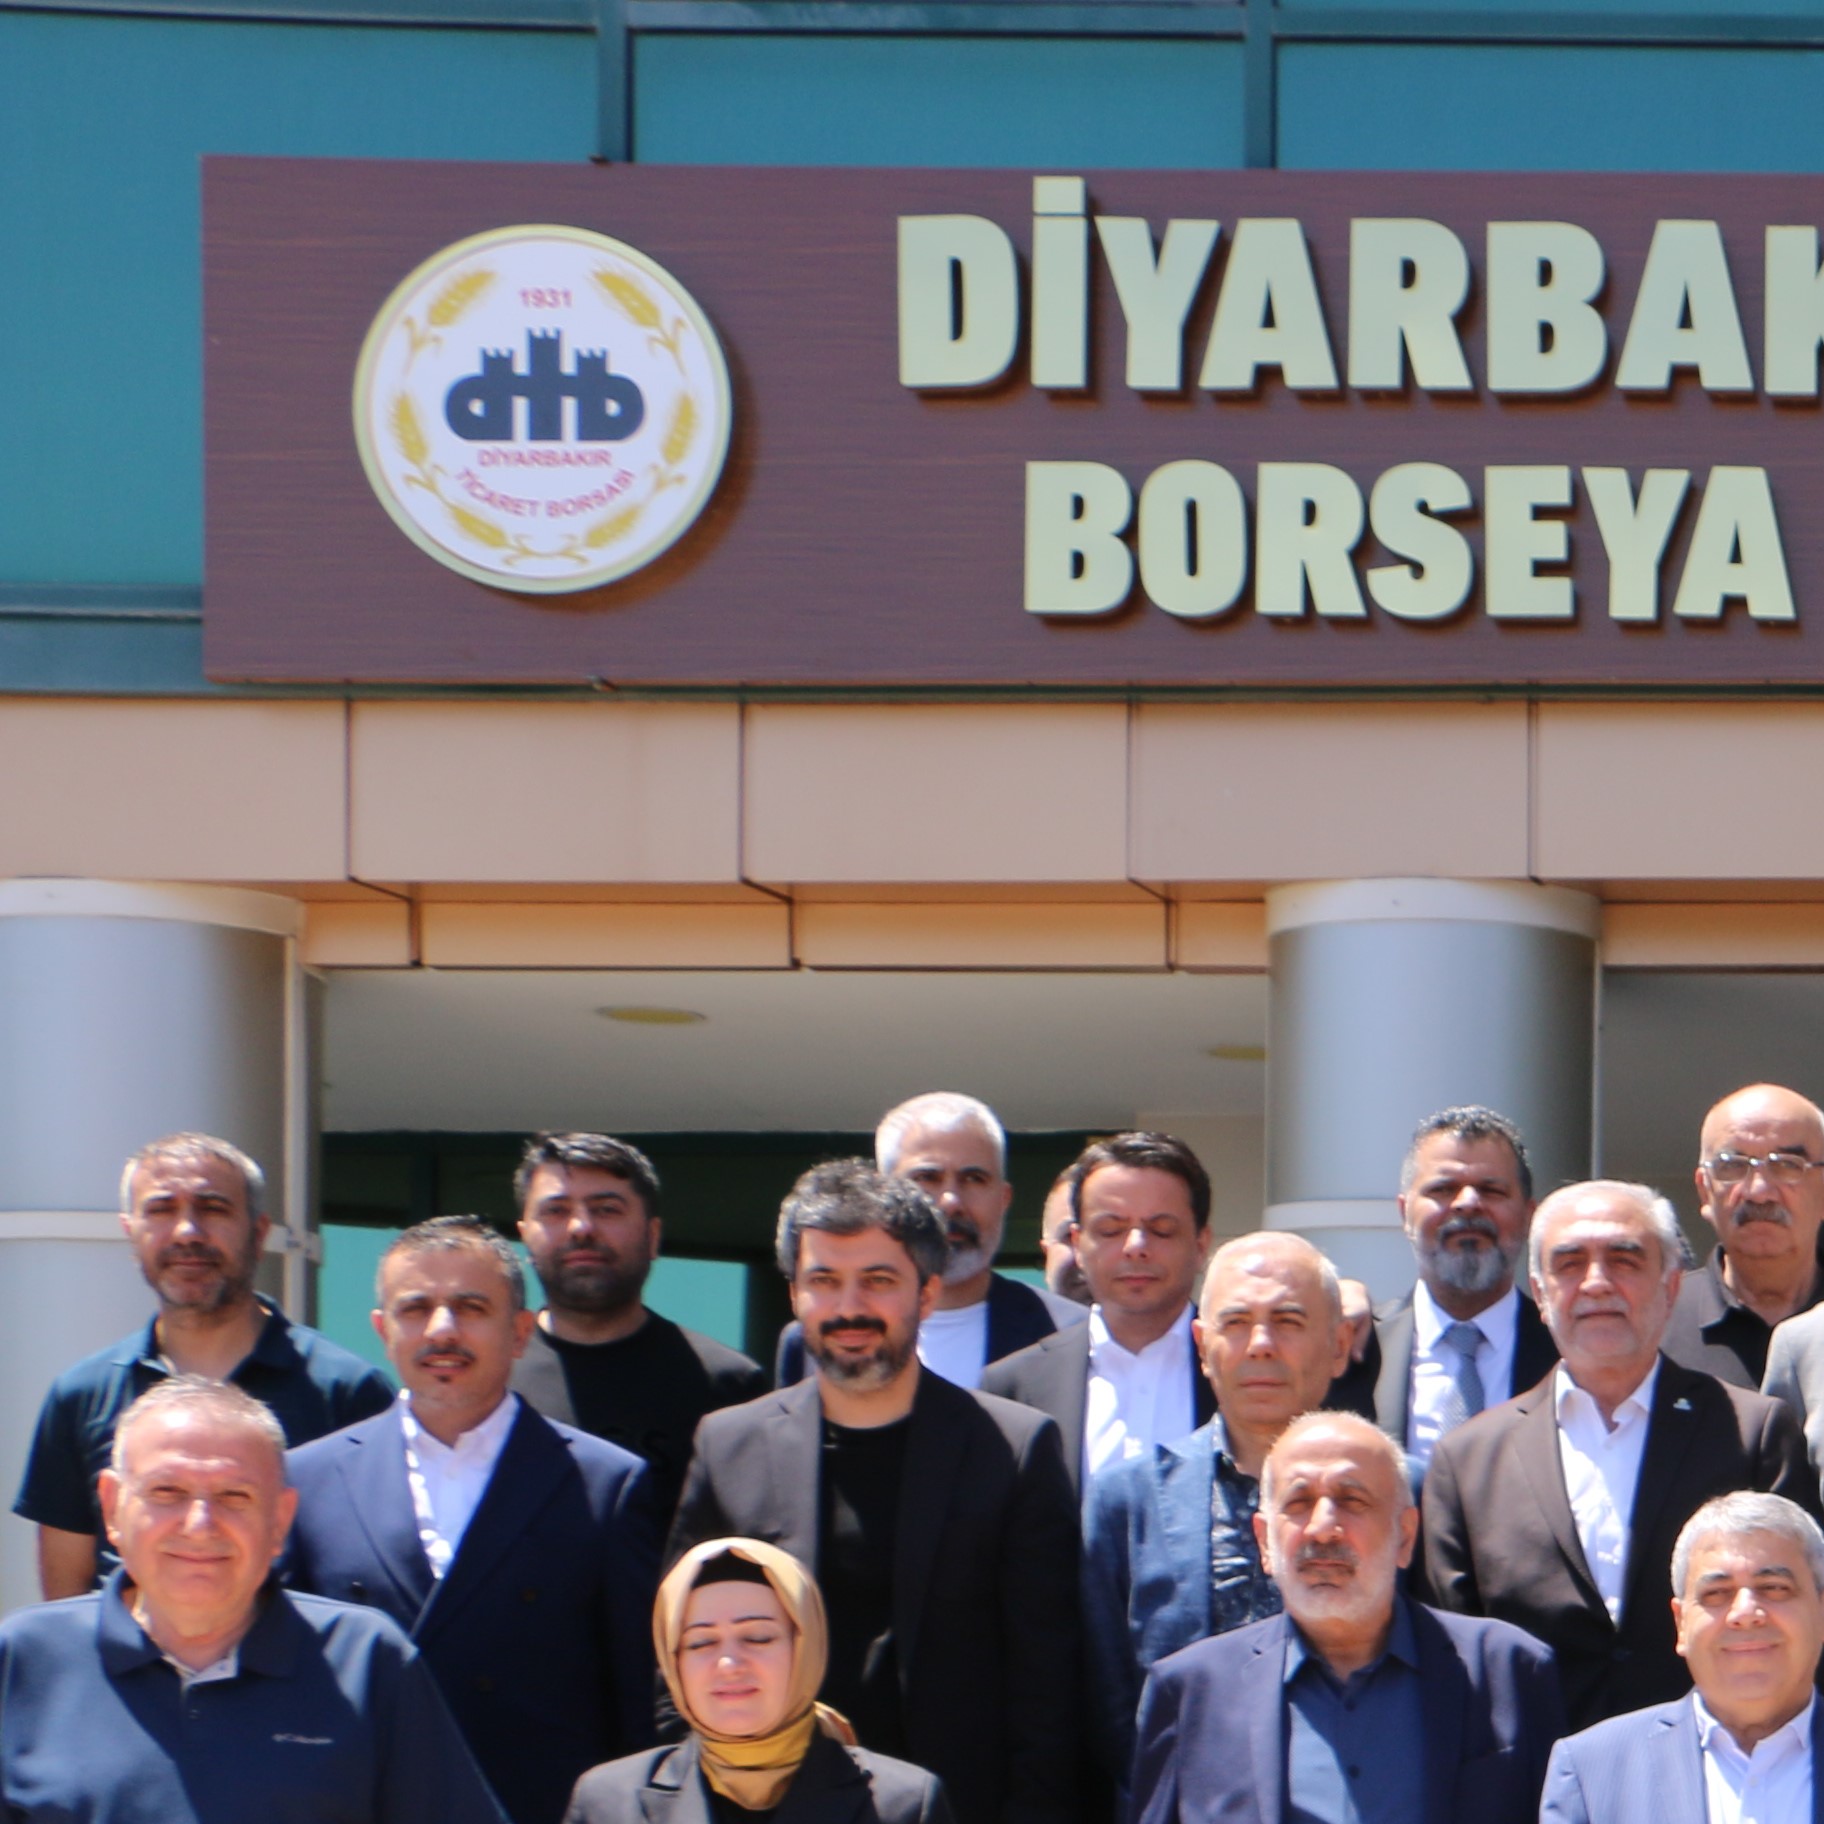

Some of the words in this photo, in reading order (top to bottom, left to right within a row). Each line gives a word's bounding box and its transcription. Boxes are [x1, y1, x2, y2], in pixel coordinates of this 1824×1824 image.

[519, 287, 573, 308] 1931
[546, 467, 635, 518] BORSASI
[1024, 460, 1795, 620] BORSEYA
